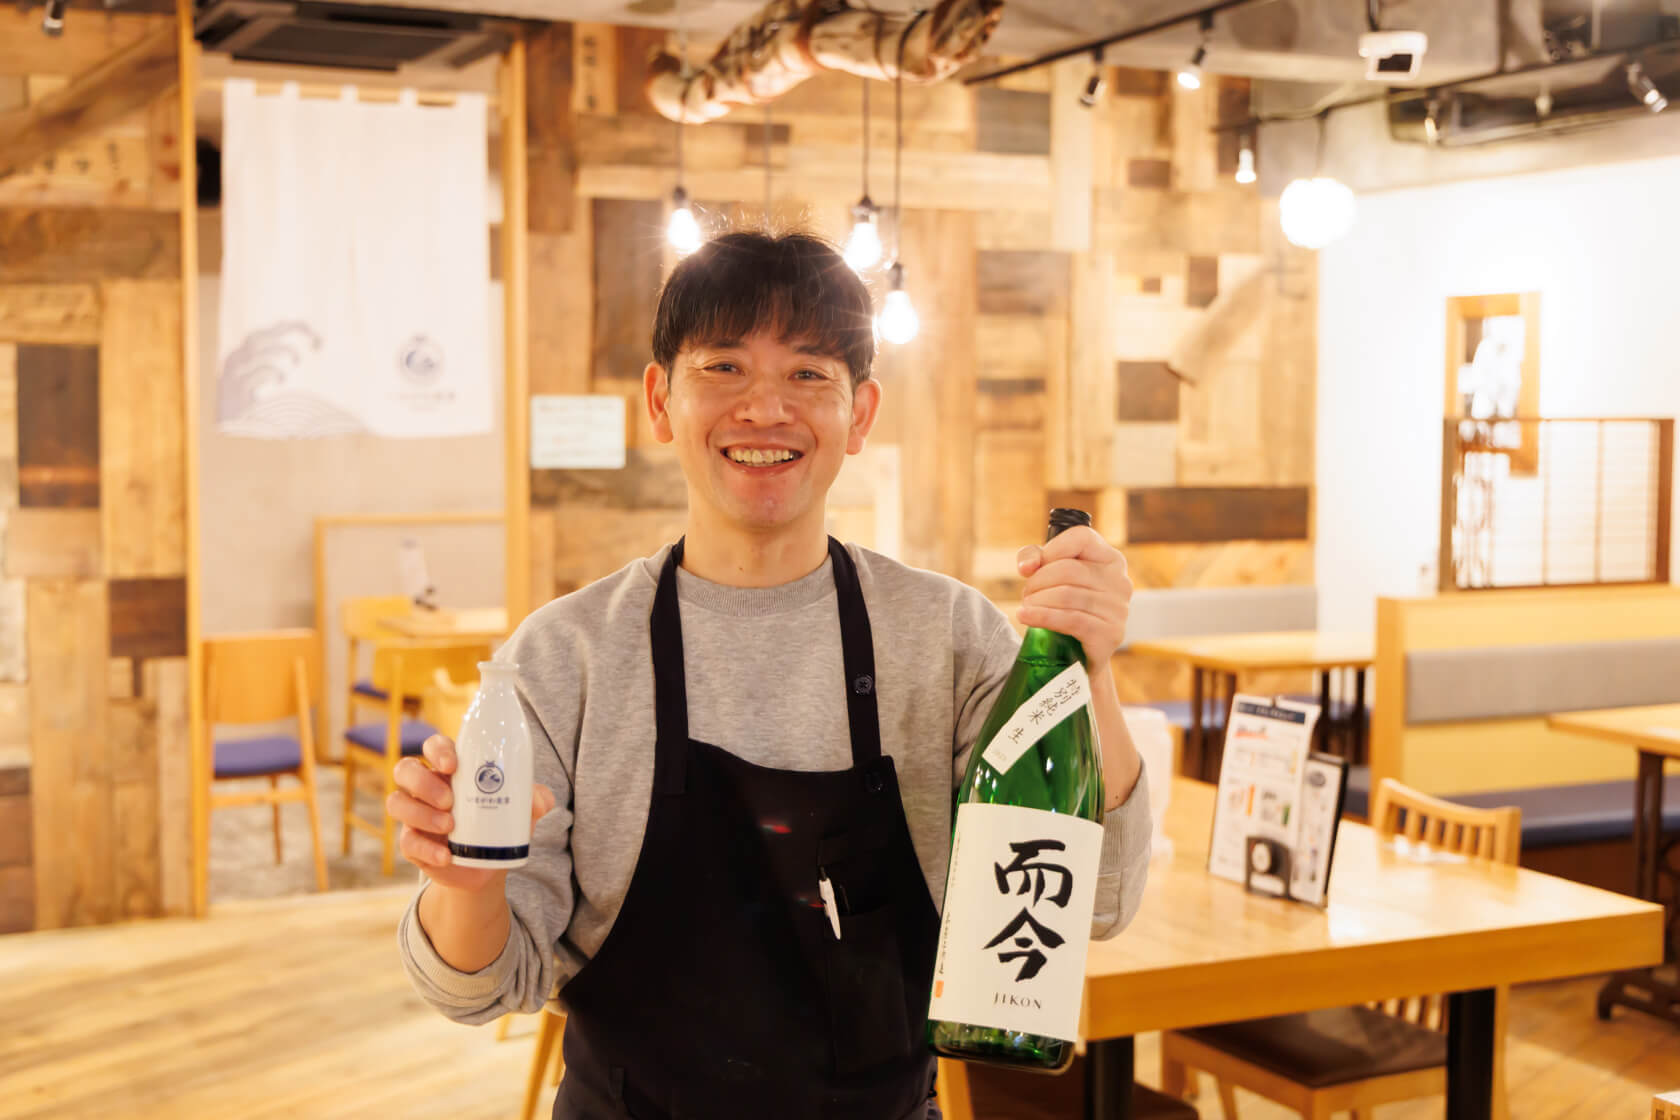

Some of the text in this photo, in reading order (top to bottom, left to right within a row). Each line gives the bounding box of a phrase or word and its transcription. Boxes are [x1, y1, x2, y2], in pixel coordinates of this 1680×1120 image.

[1008, 679, 1081, 744] 特別純米 生
[983, 839, 1074, 982] 而今
[992, 992, 1043, 1010] JIKON
